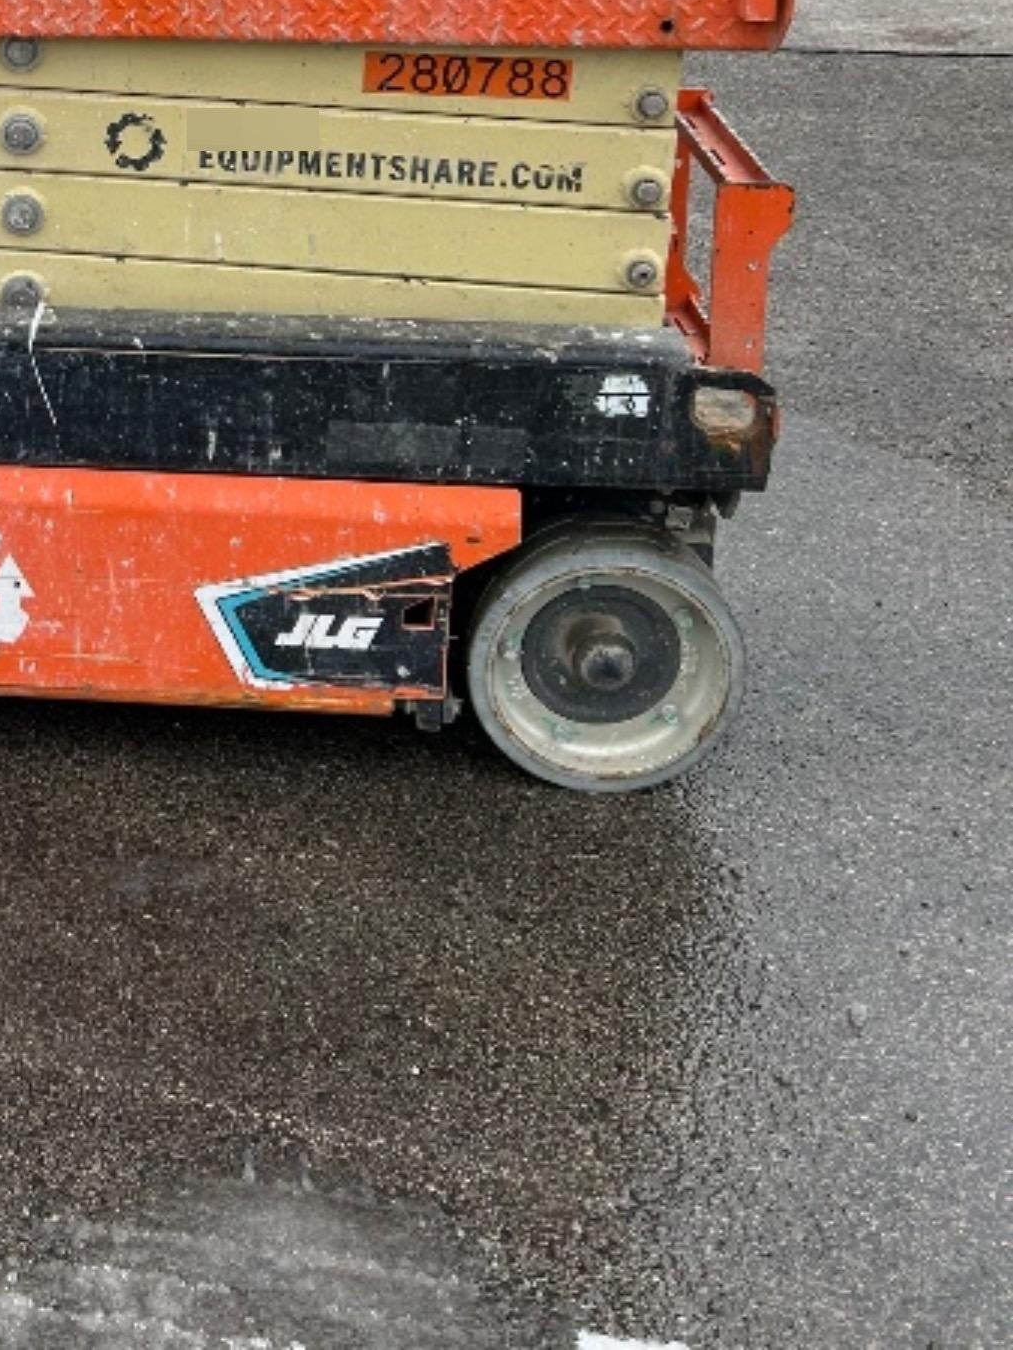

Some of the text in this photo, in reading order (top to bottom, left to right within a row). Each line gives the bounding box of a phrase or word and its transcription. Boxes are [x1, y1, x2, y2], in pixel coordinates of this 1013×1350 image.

[377, 54, 568, 98] 280788
[199, 149, 583, 193] EQUIPMENTSHARE.COM
[275, 614, 383, 649] JLG
